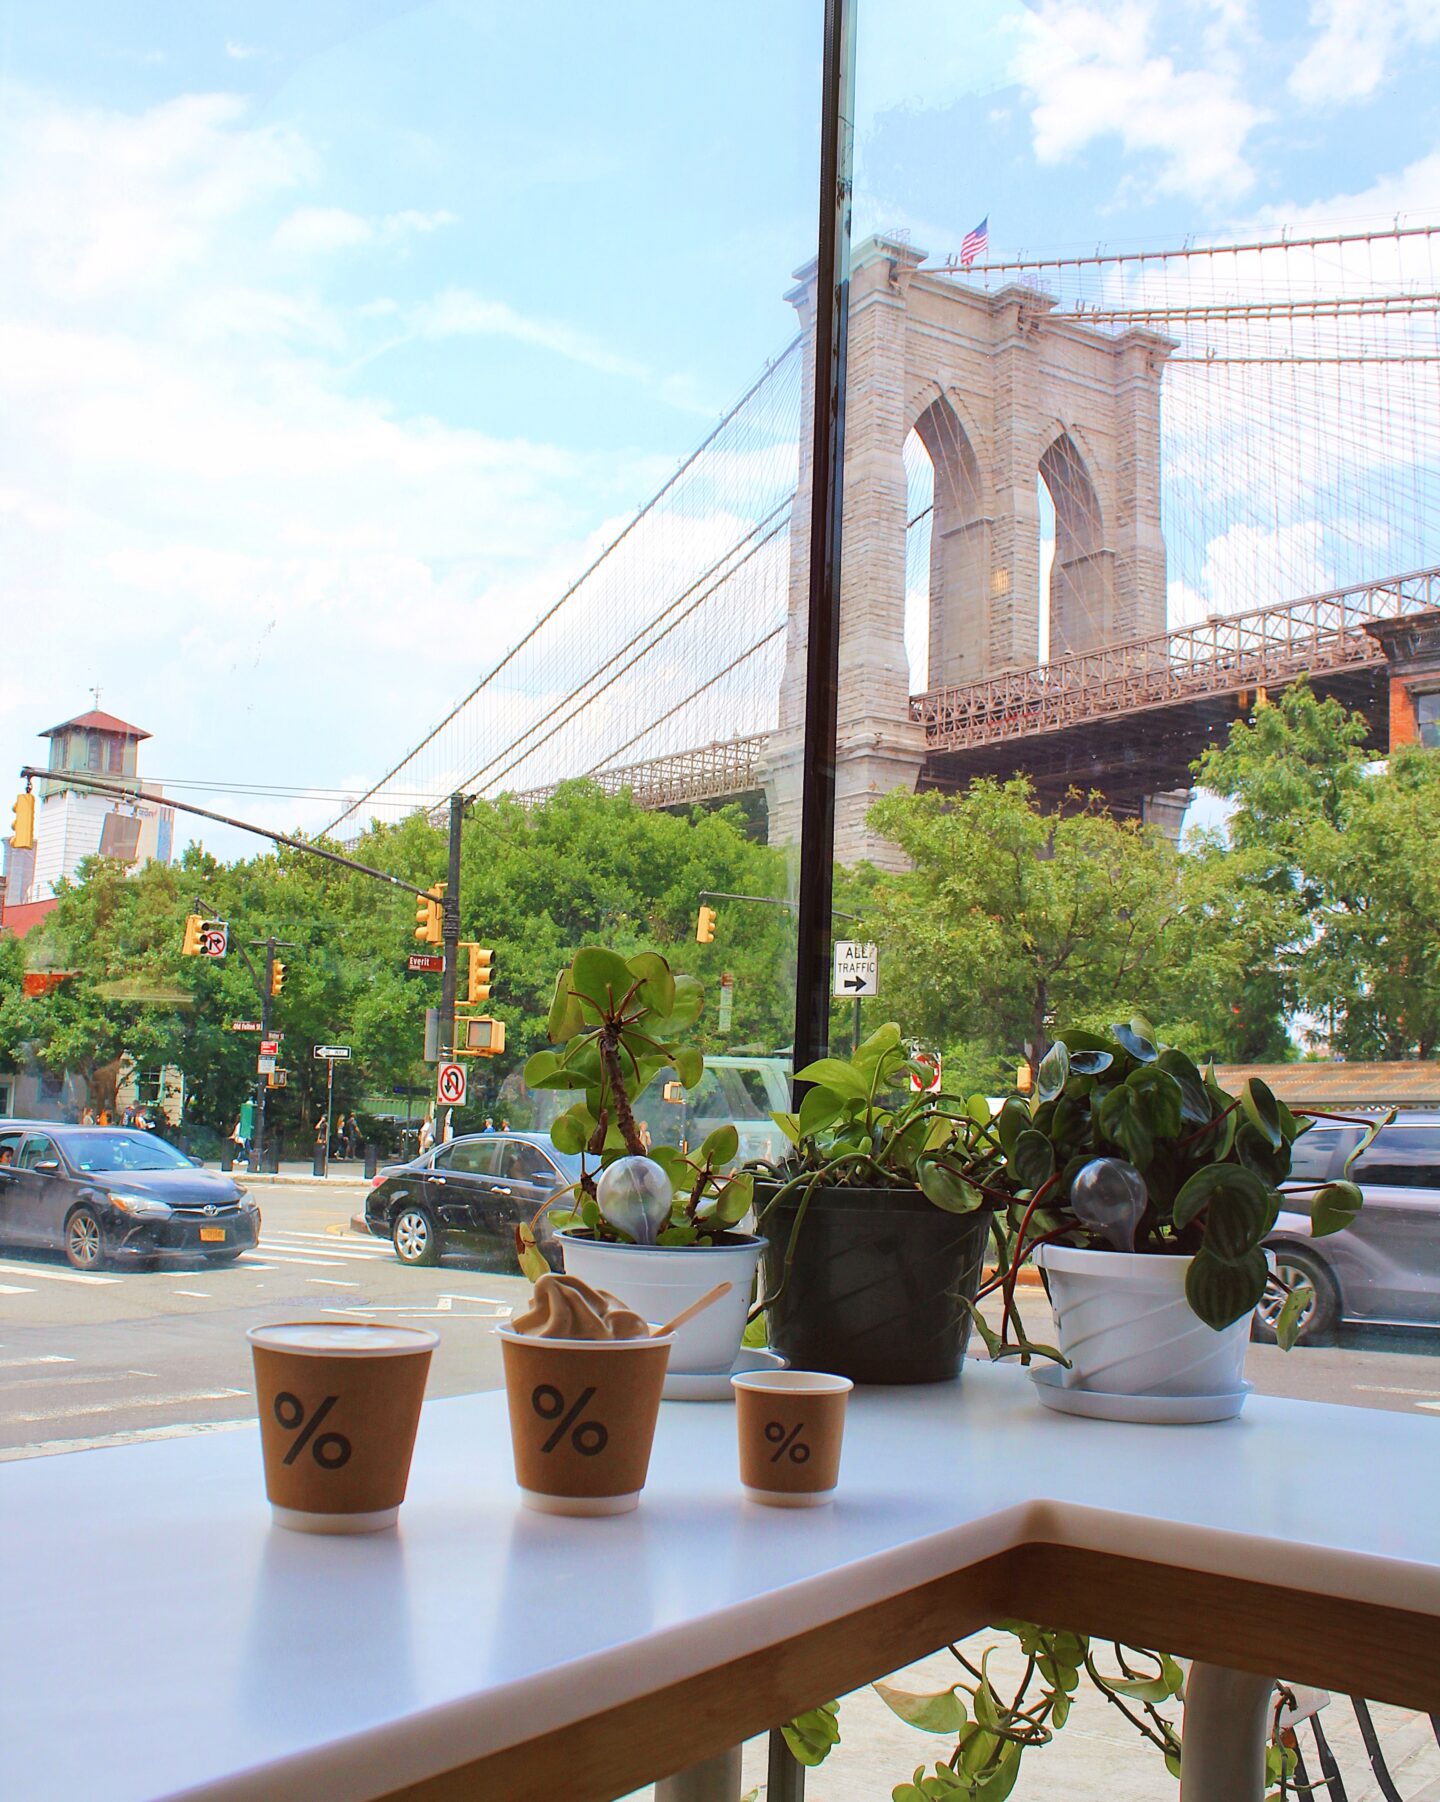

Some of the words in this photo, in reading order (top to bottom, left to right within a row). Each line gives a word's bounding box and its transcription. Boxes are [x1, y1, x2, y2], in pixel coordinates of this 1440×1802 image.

[845, 946, 868, 958] ALL
[409, 956, 430, 966] Everit
[837, 962, 875, 973] TRAFFIC
